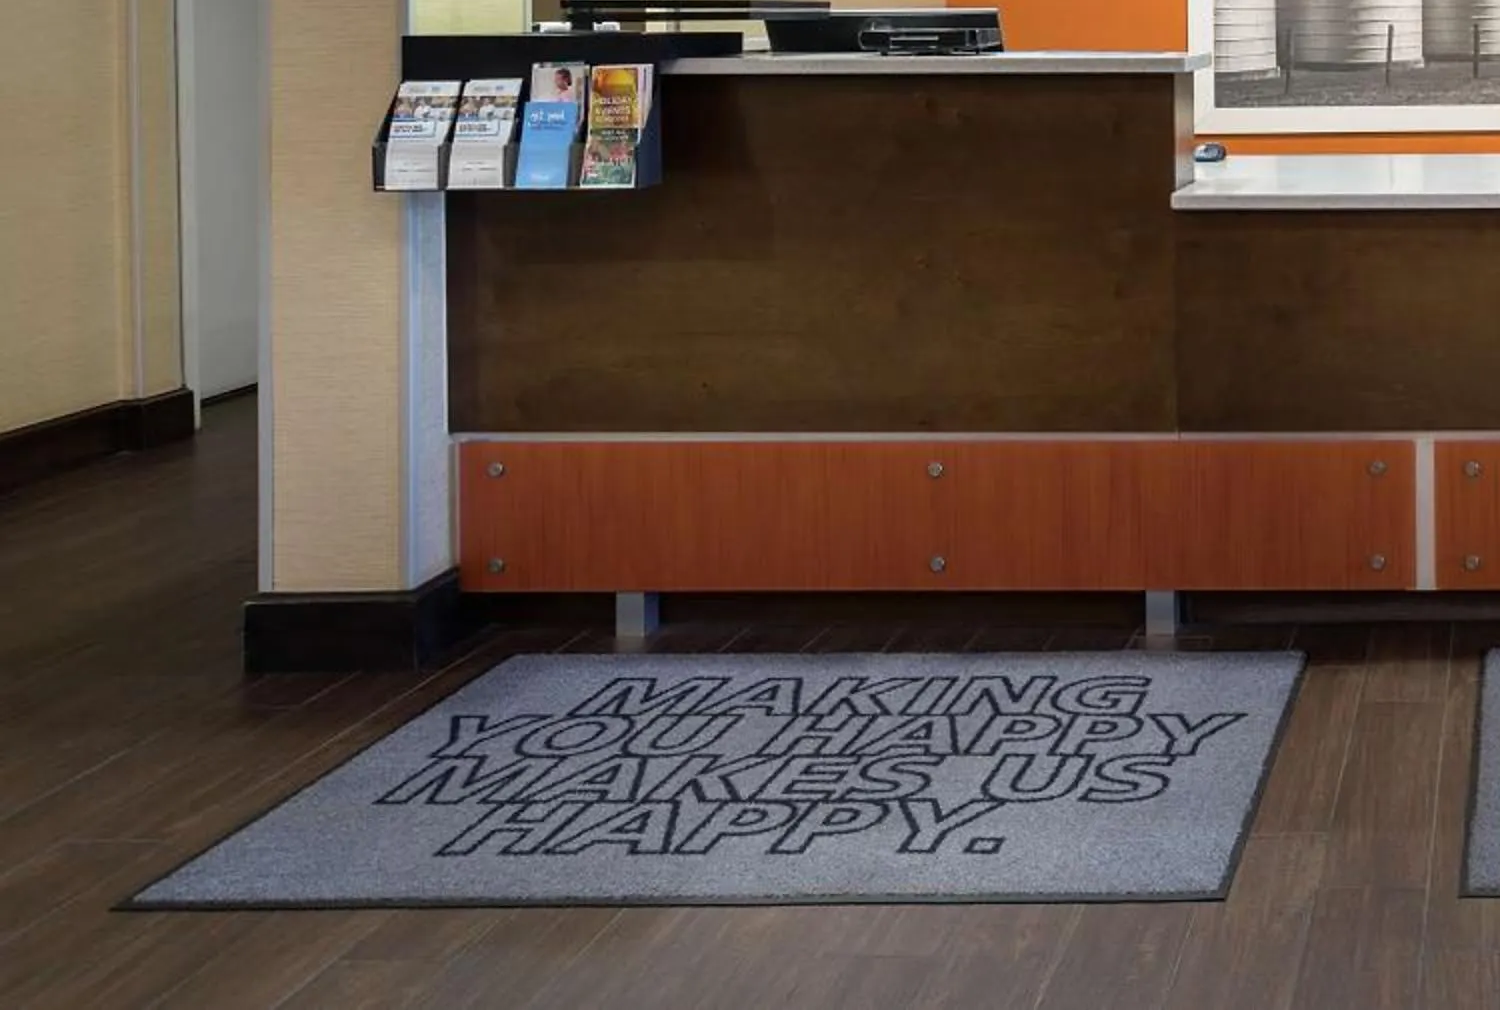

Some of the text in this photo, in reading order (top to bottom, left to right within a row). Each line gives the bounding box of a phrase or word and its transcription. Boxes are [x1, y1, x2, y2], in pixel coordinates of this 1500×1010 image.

[566, 675, 1153, 717] MAKING
[427, 712, 1249, 759] YOU HAPPY
[372, 753, 1177, 805] MAKES US
[432, 797, 1007, 857] HAPPY.
